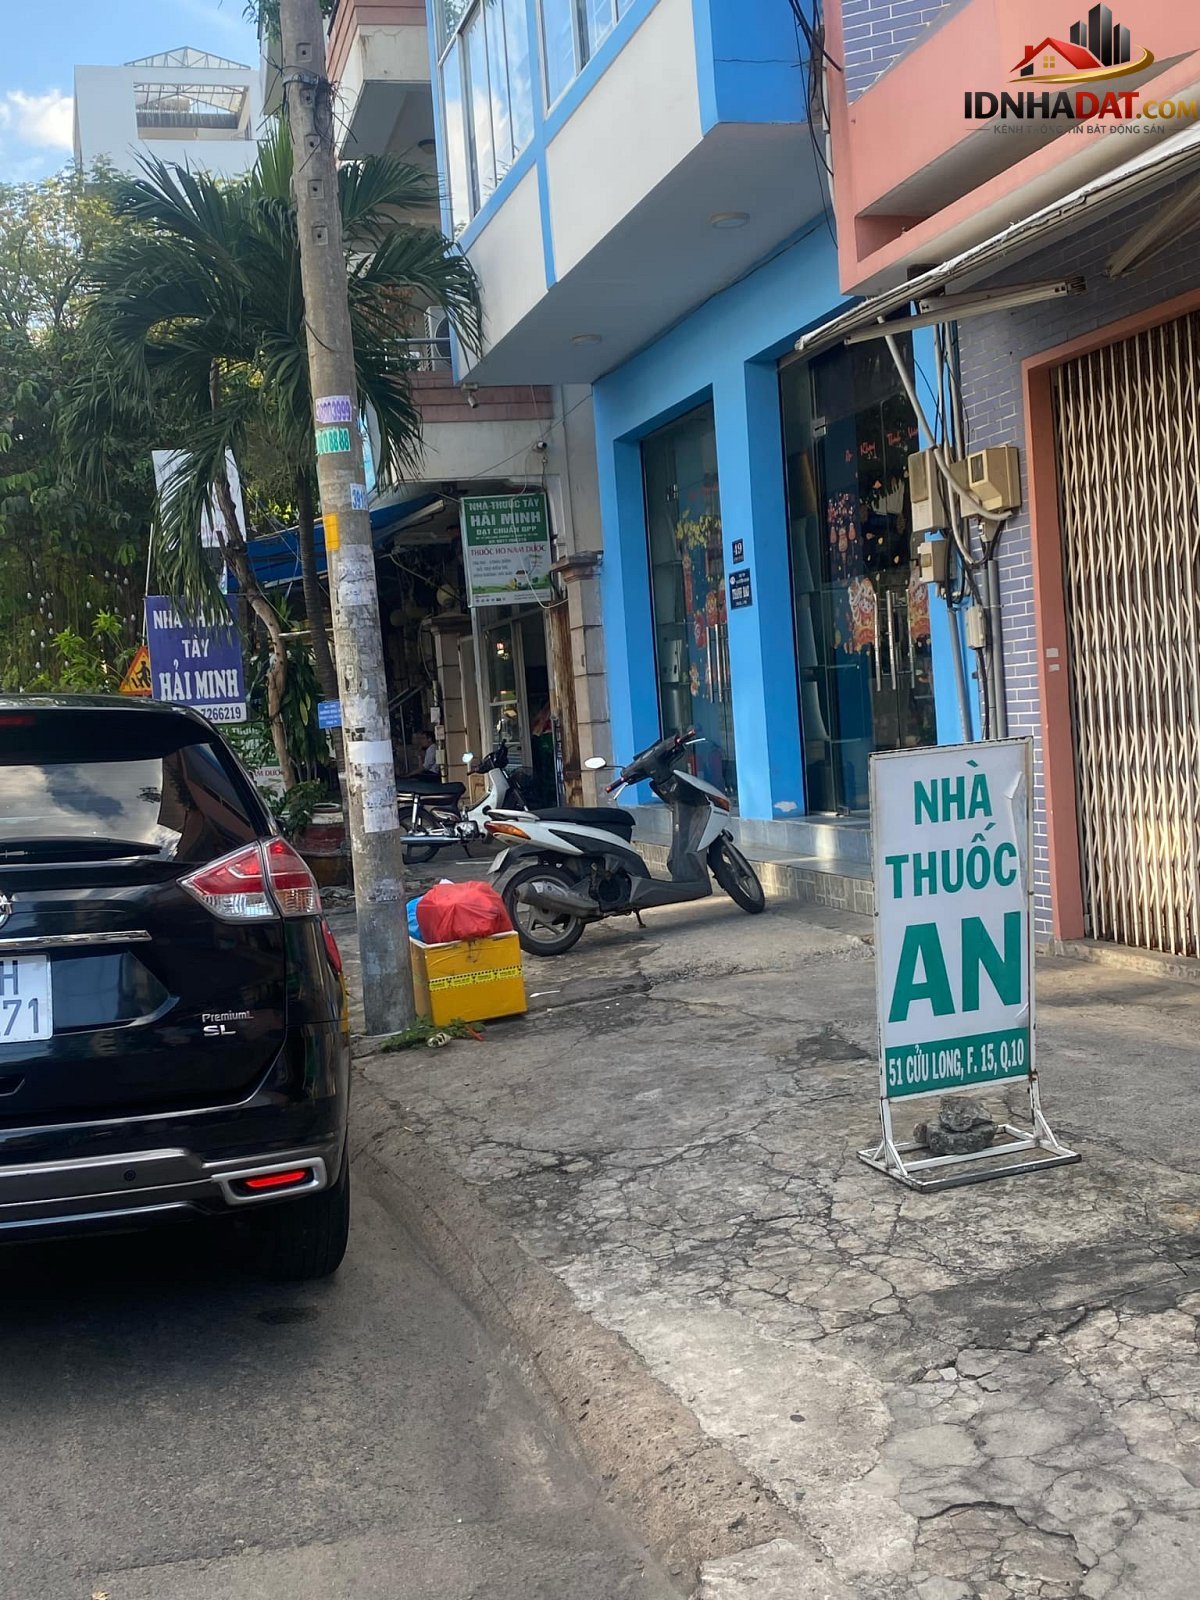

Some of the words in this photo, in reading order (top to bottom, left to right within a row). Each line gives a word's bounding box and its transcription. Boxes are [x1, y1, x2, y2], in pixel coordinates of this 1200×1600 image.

[470, 511, 496, 527] HẢI
[501, 511, 541, 525] MINH
[159, 659, 192, 701] HẢI
[194, 669, 239, 700] MINH
[914, 760, 992, 825] NHÀ
[885, 823, 1017, 899] THUỐC
[888, 911, 1021, 1023] AN
[203, 1024, 237, 1037] SL
[889, 1057, 903, 1086] 51
[906, 1044, 929, 1084] CỬU
[932, 1048, 964, 1080] LONG,
[967, 1046, 978, 1074] F.
[981, 1043, 998, 1075] 15,
[1000, 1038, 1024, 1072] Q.10
